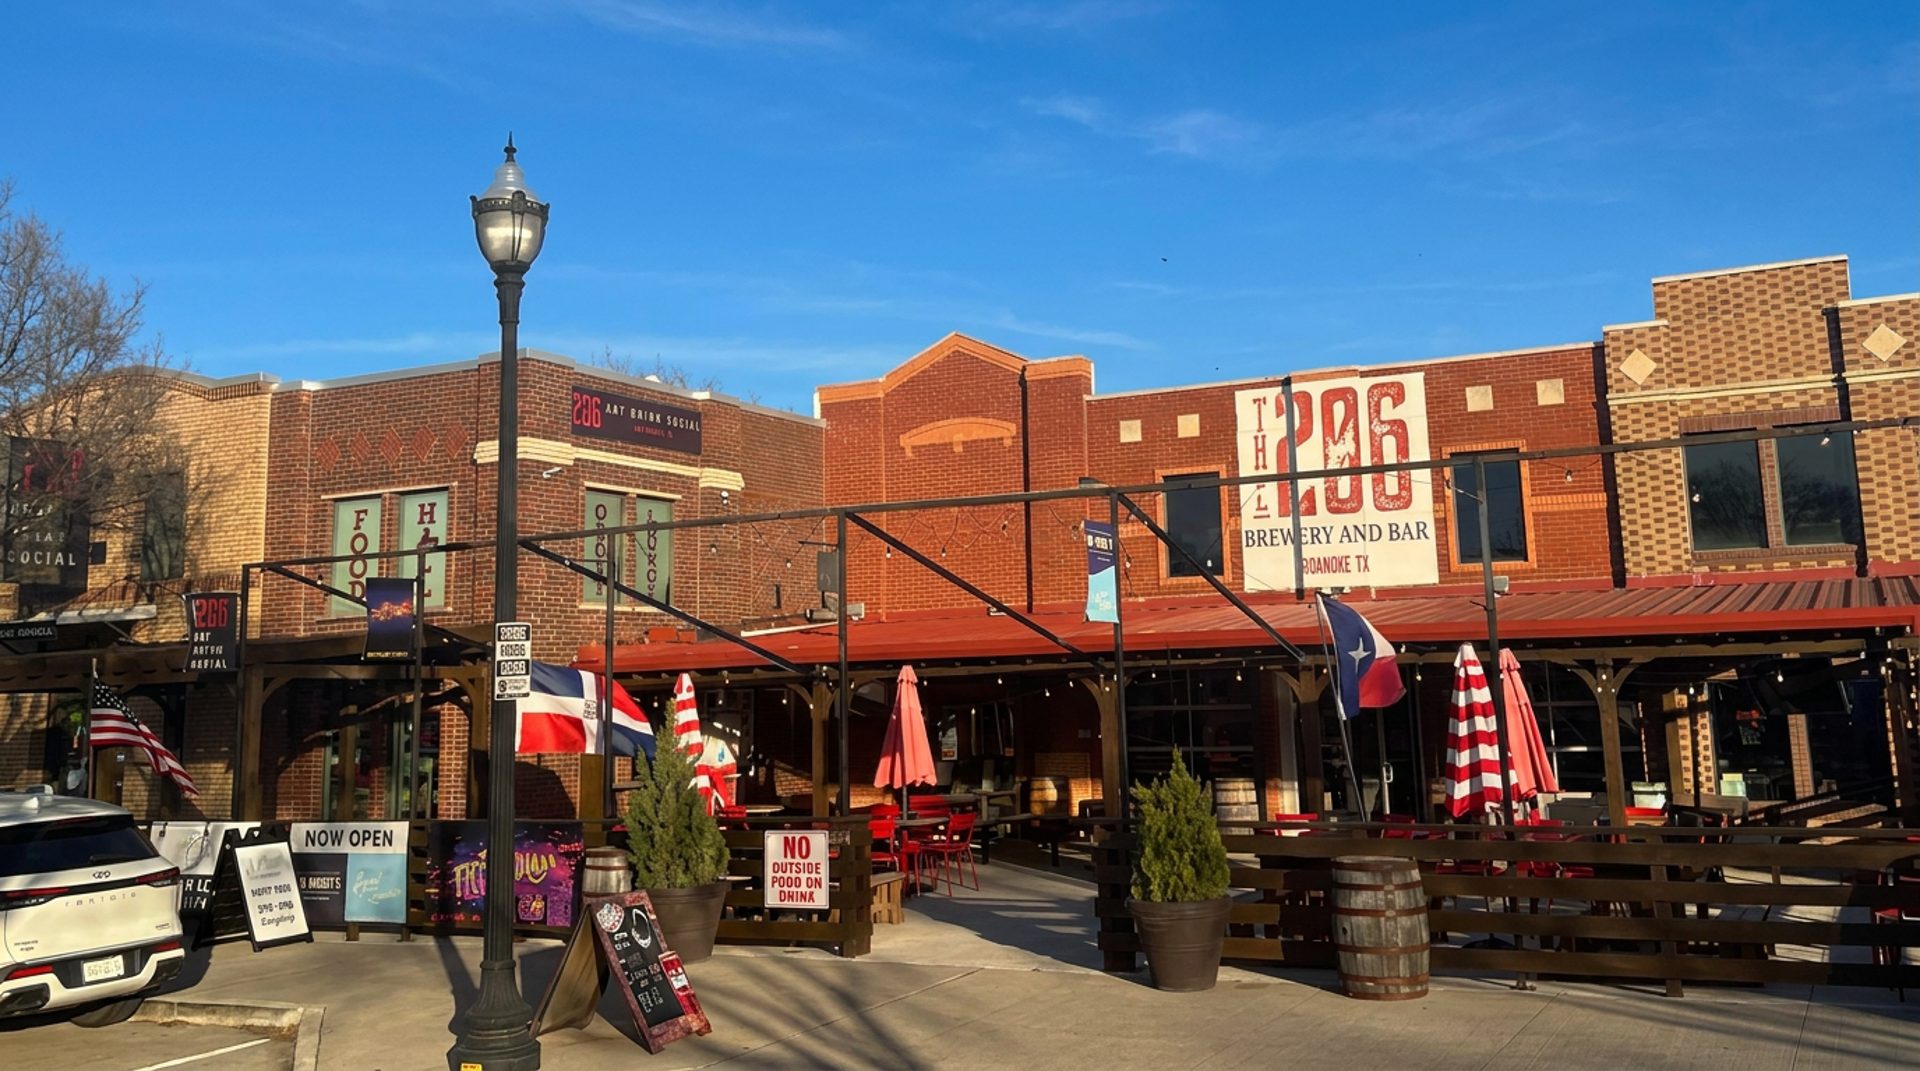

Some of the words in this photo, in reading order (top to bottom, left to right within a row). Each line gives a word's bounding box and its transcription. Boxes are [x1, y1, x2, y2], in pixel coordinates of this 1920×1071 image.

[1275, 381, 1413, 518] 206
[1245, 525, 1335, 548] BREWERY
[1340, 523, 1383, 543] AND
[1388, 520, 1431, 542] BAR
[1354, 554, 1371, 573] TX
[304, 829, 344, 848] NOW
[348, 829, 394, 847] OPEN
[783, 835, 811, 859] NO
